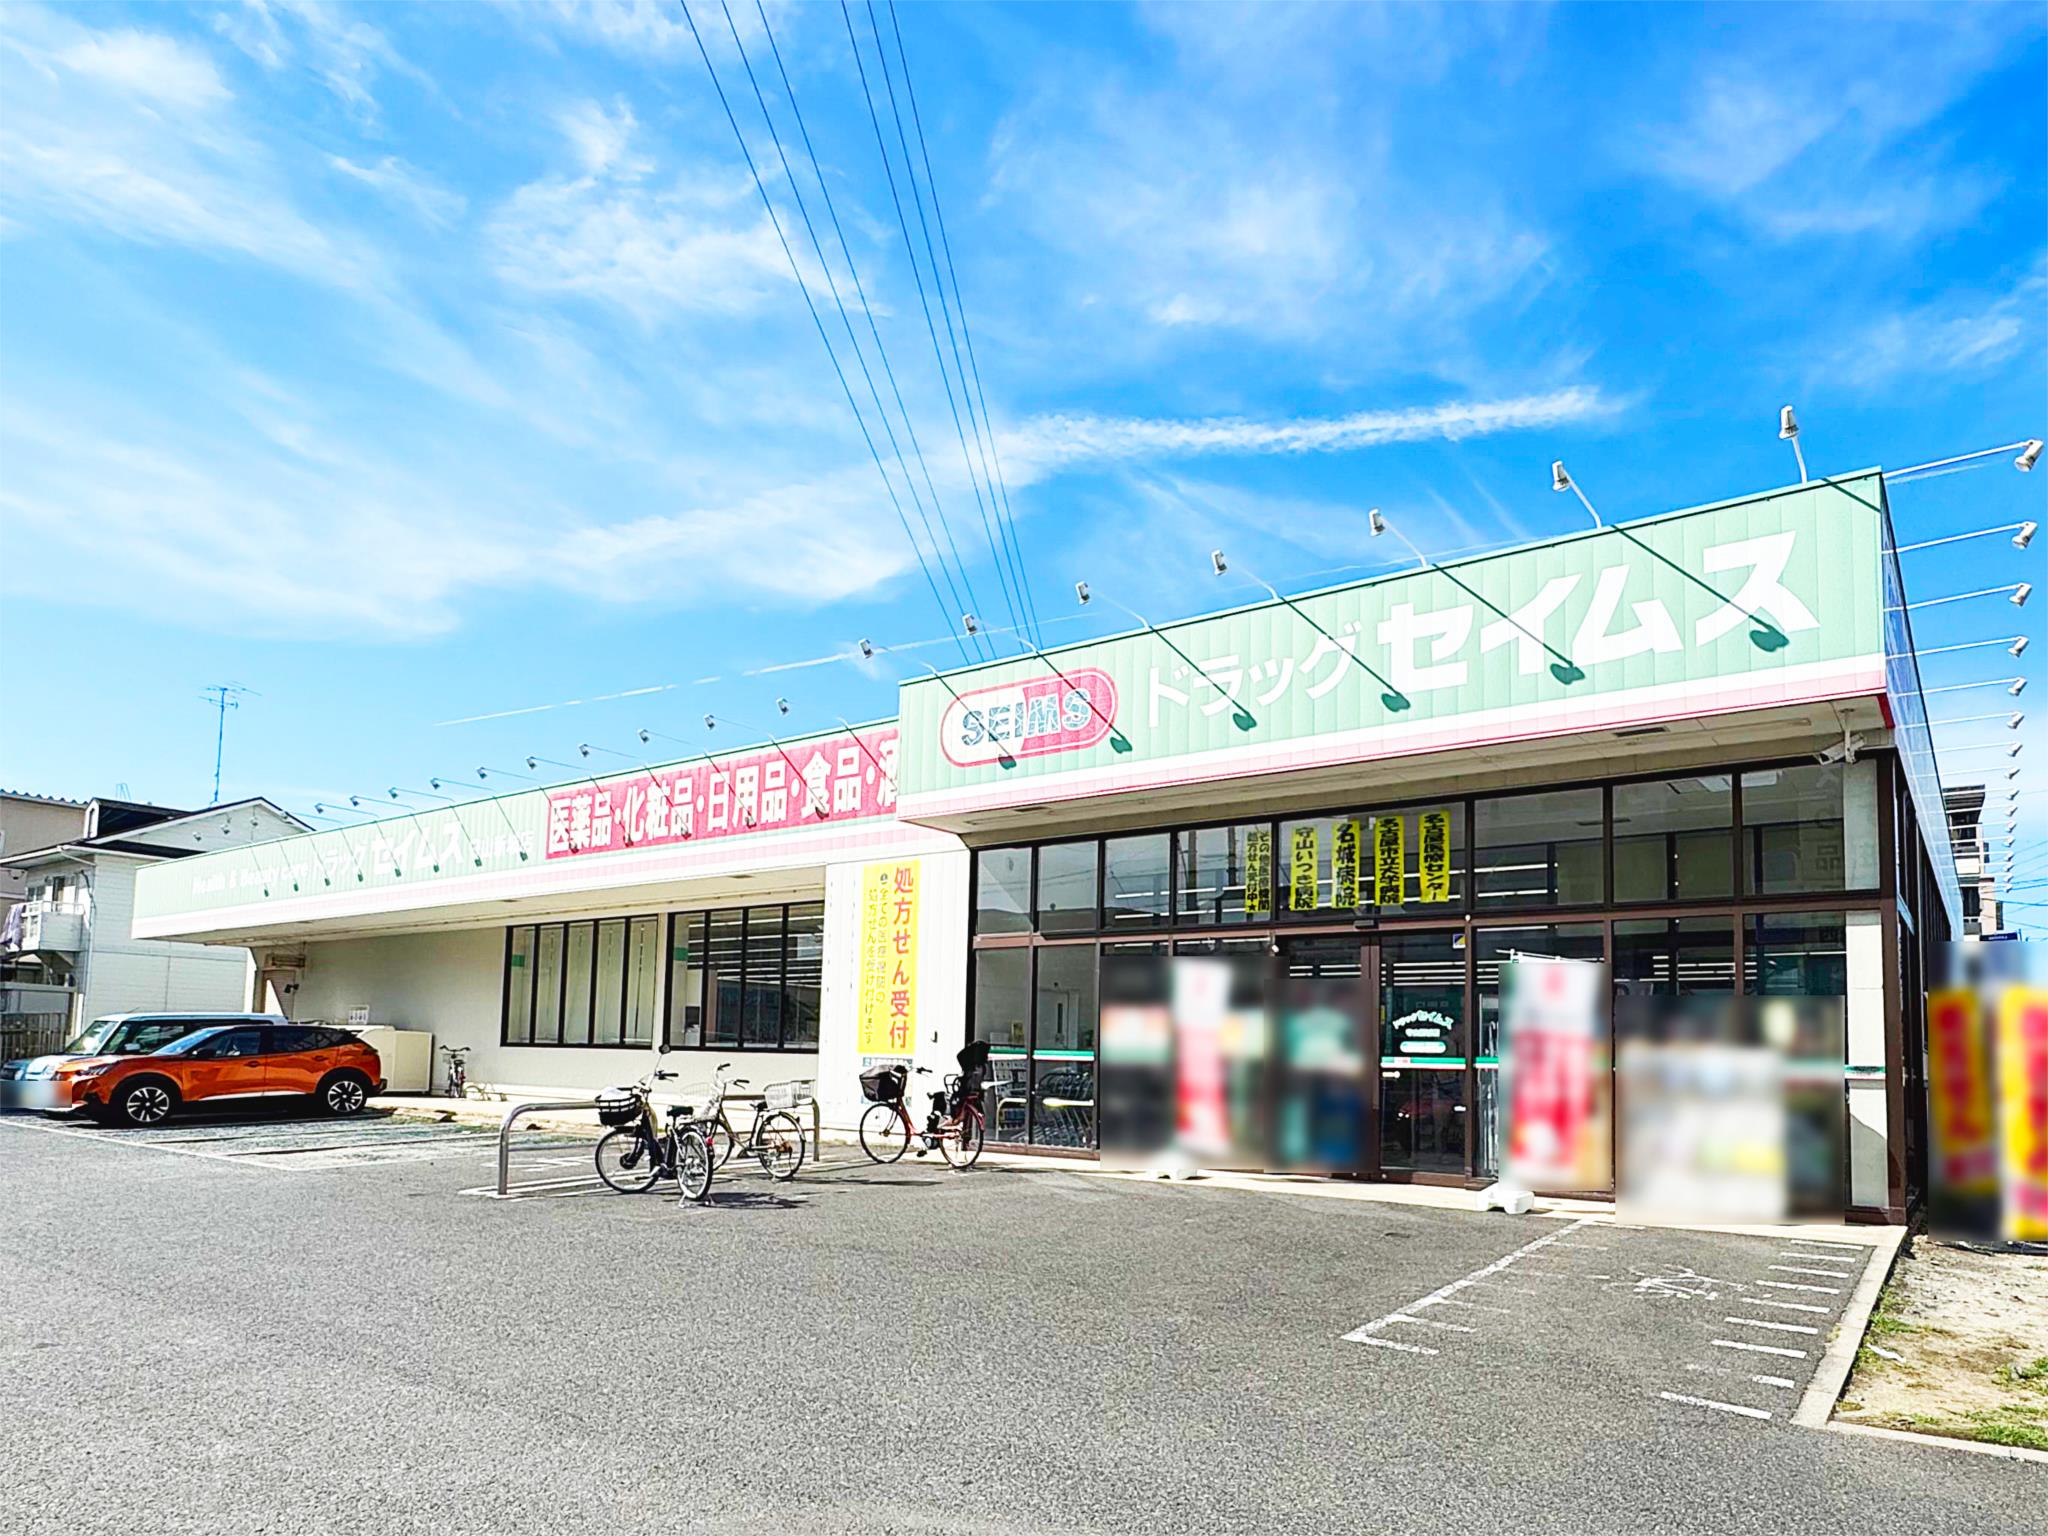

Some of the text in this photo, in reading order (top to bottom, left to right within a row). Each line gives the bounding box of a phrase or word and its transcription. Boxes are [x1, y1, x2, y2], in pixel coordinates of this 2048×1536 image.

[1149, 531, 1821, 728] ドラッグセイムス
[961, 687, 1092, 746] SEIMS
[1335, 823, 1357, 907] 名城病院
[889, 867, 914, 1049] 処方せん受付
